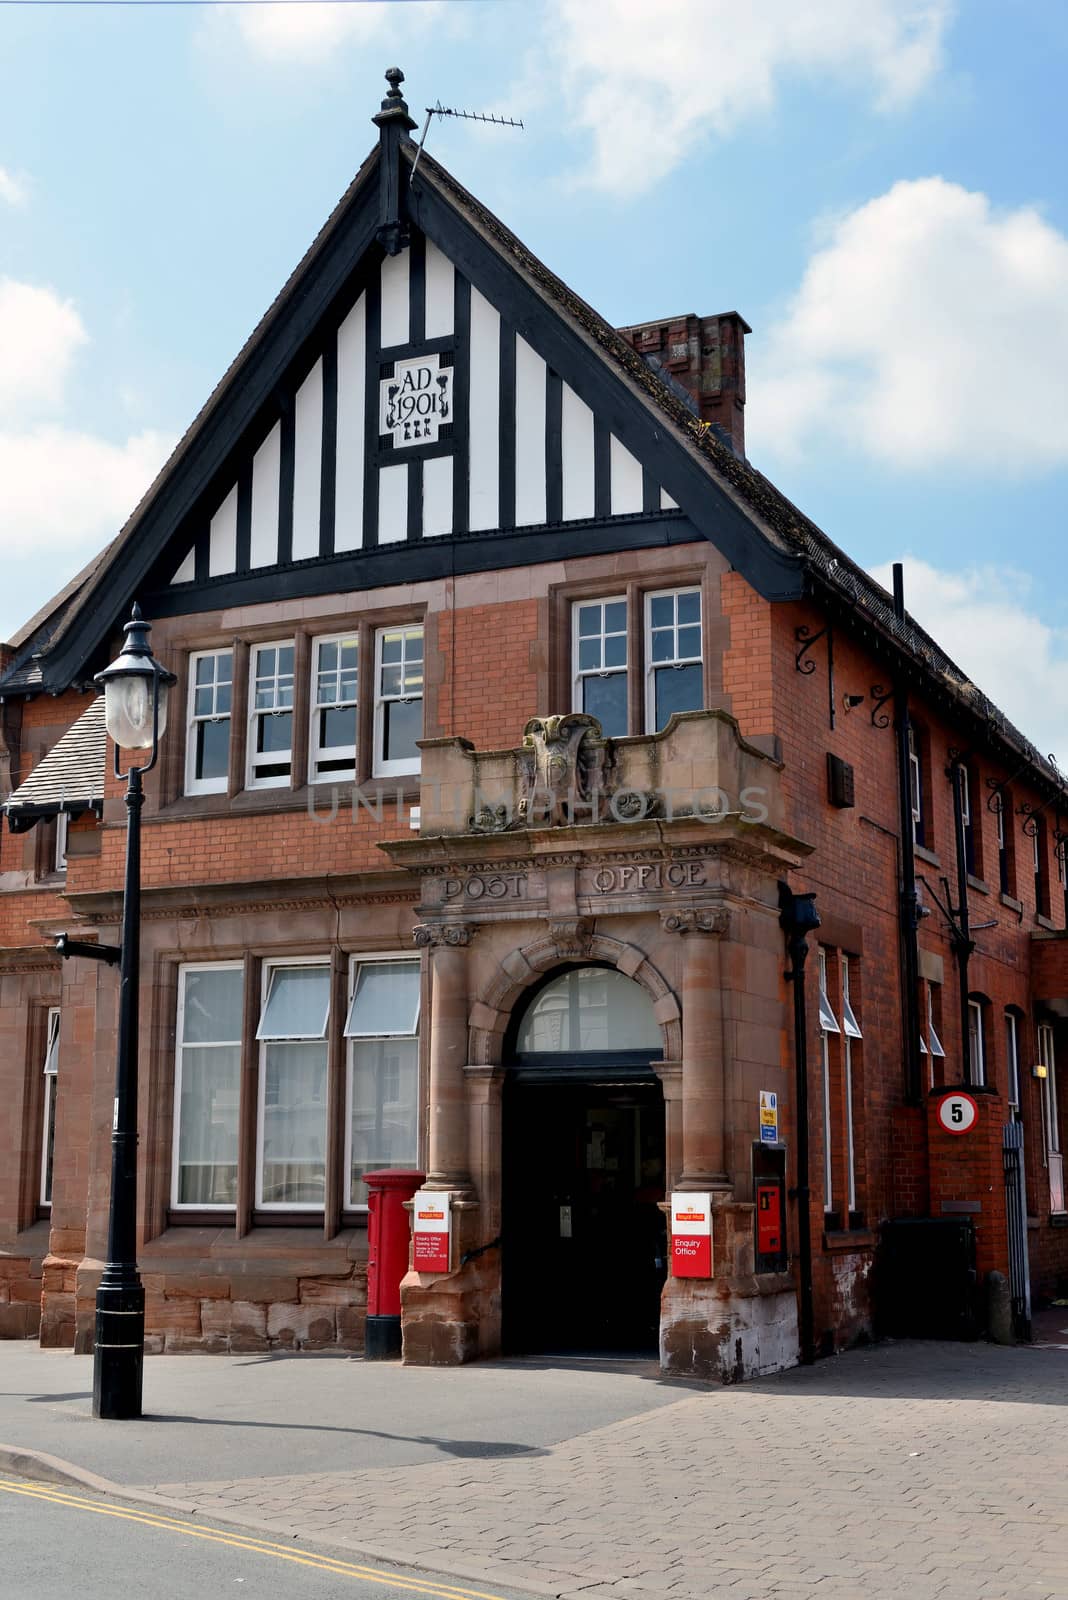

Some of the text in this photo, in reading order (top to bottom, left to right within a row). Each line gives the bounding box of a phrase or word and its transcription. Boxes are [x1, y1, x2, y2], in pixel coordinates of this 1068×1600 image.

[400, 367, 432, 395] AD
[397, 393, 437, 424] 1901
[441, 862, 707, 900] POST OFFICE
[951, 1103, 963, 1124] 5
[675, 1239, 700, 1248] Enquiry
